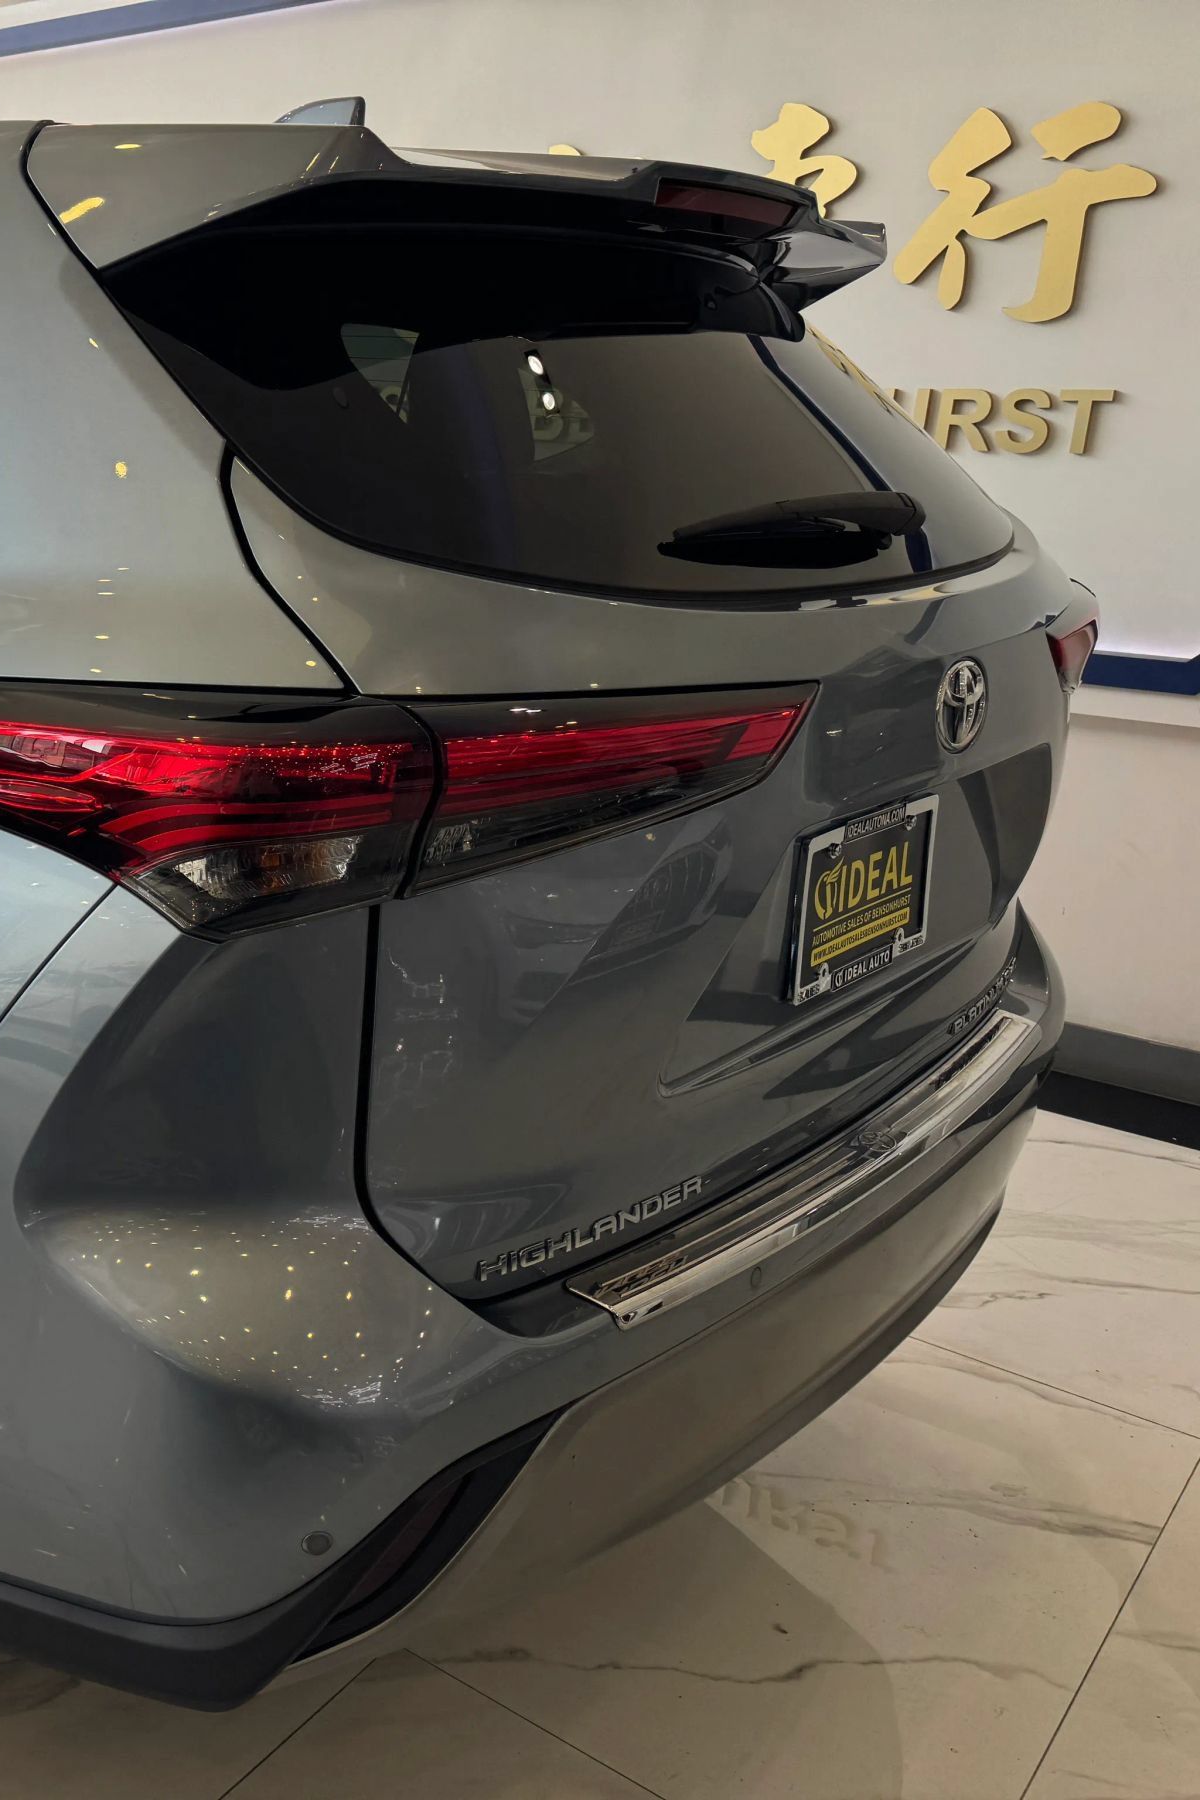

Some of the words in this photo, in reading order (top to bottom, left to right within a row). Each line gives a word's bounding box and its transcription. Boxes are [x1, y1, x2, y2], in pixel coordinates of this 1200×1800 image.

[839, 841, 912, 912] IDEAL
[812, 920, 847, 947] AUTOMOTIVE
[847, 914, 864, 931] SALES
[872, 894, 911, 919] BENSONHURST
[845, 964, 867, 982] IDEAL
[869, 950, 890, 970] AUTO
[476, 1175, 703, 1283] HIGHLANDER
